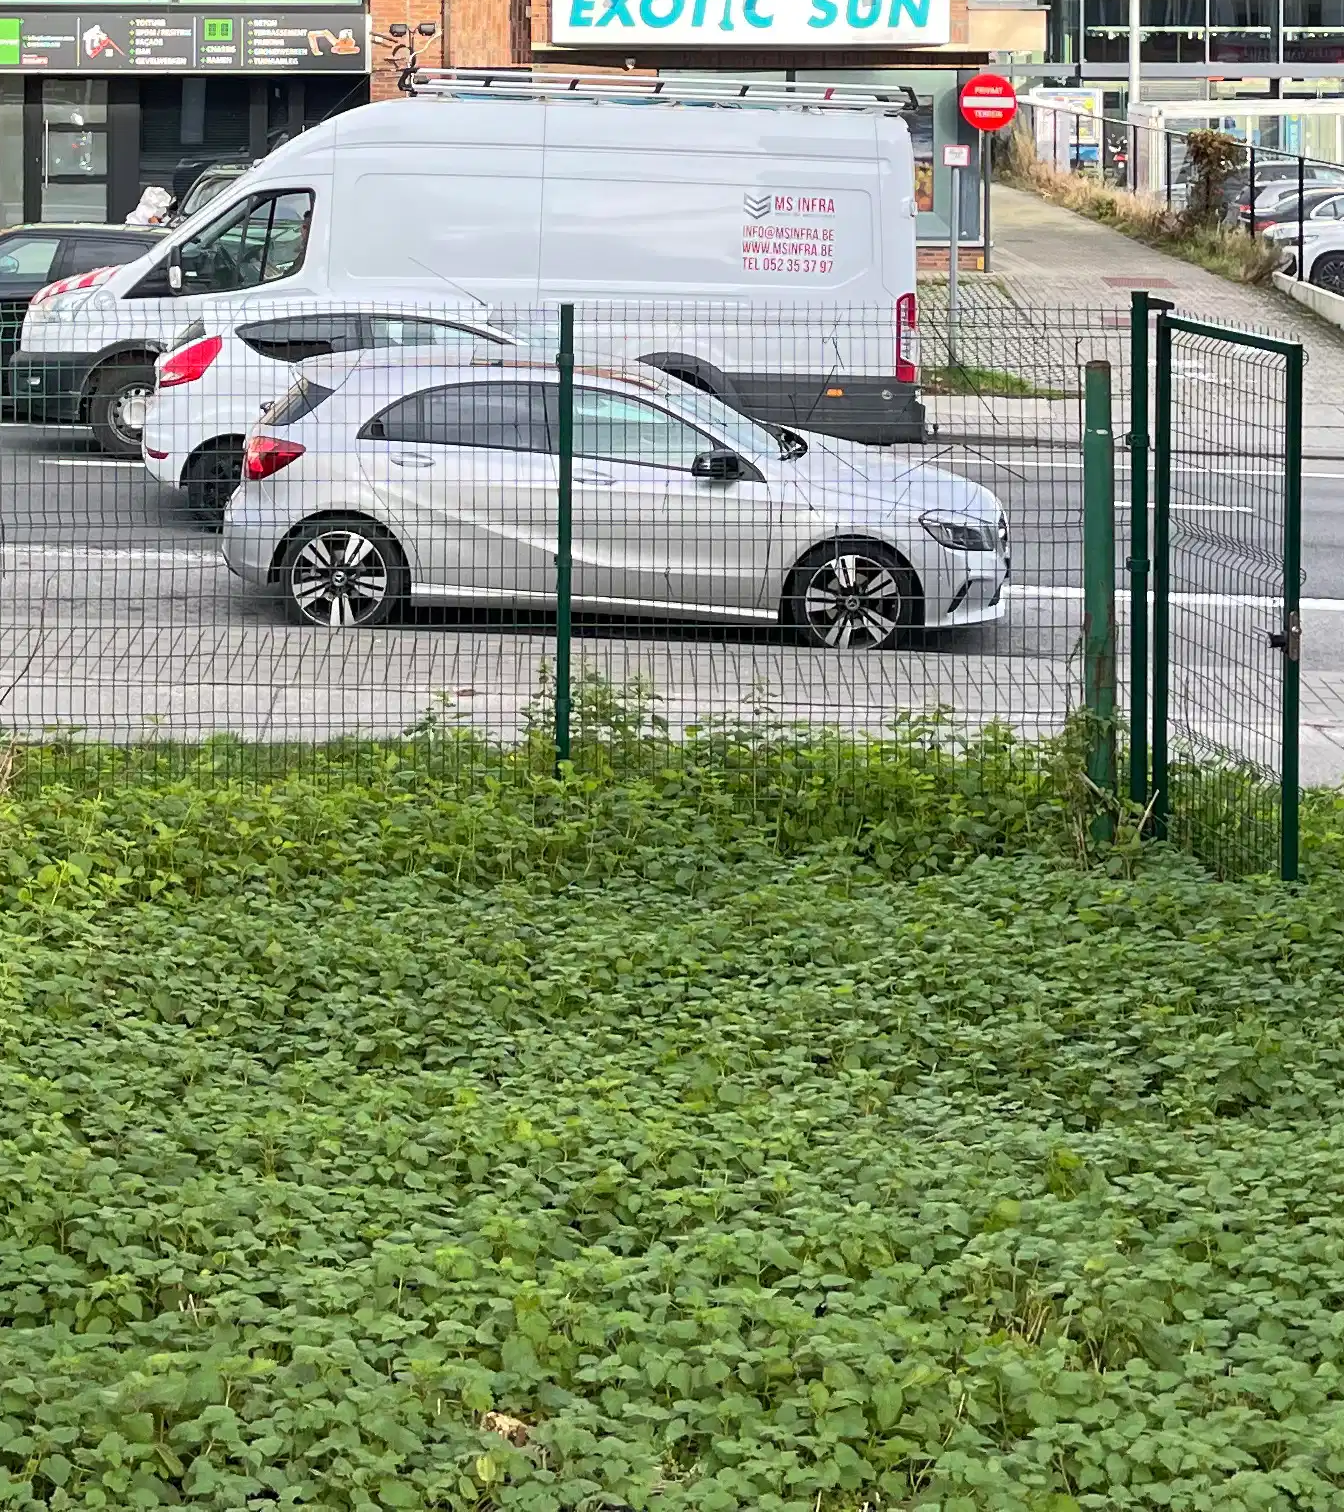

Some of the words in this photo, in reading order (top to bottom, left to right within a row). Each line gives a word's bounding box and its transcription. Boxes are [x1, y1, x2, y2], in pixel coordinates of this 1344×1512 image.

[774, 195, 793, 212] MS
[798, 197, 835, 214] INFRA
[742, 225, 835, 242] INFO@MSINFRA.BE
[742, 241, 833, 258] WWW.MSINFRA.BE
[742, 257, 760, 271] TEL
[763, 257, 784, 272] 052
[786, 258, 800, 273] 35
[803, 259, 817, 273] 37
[819, 260, 834, 274] 97
